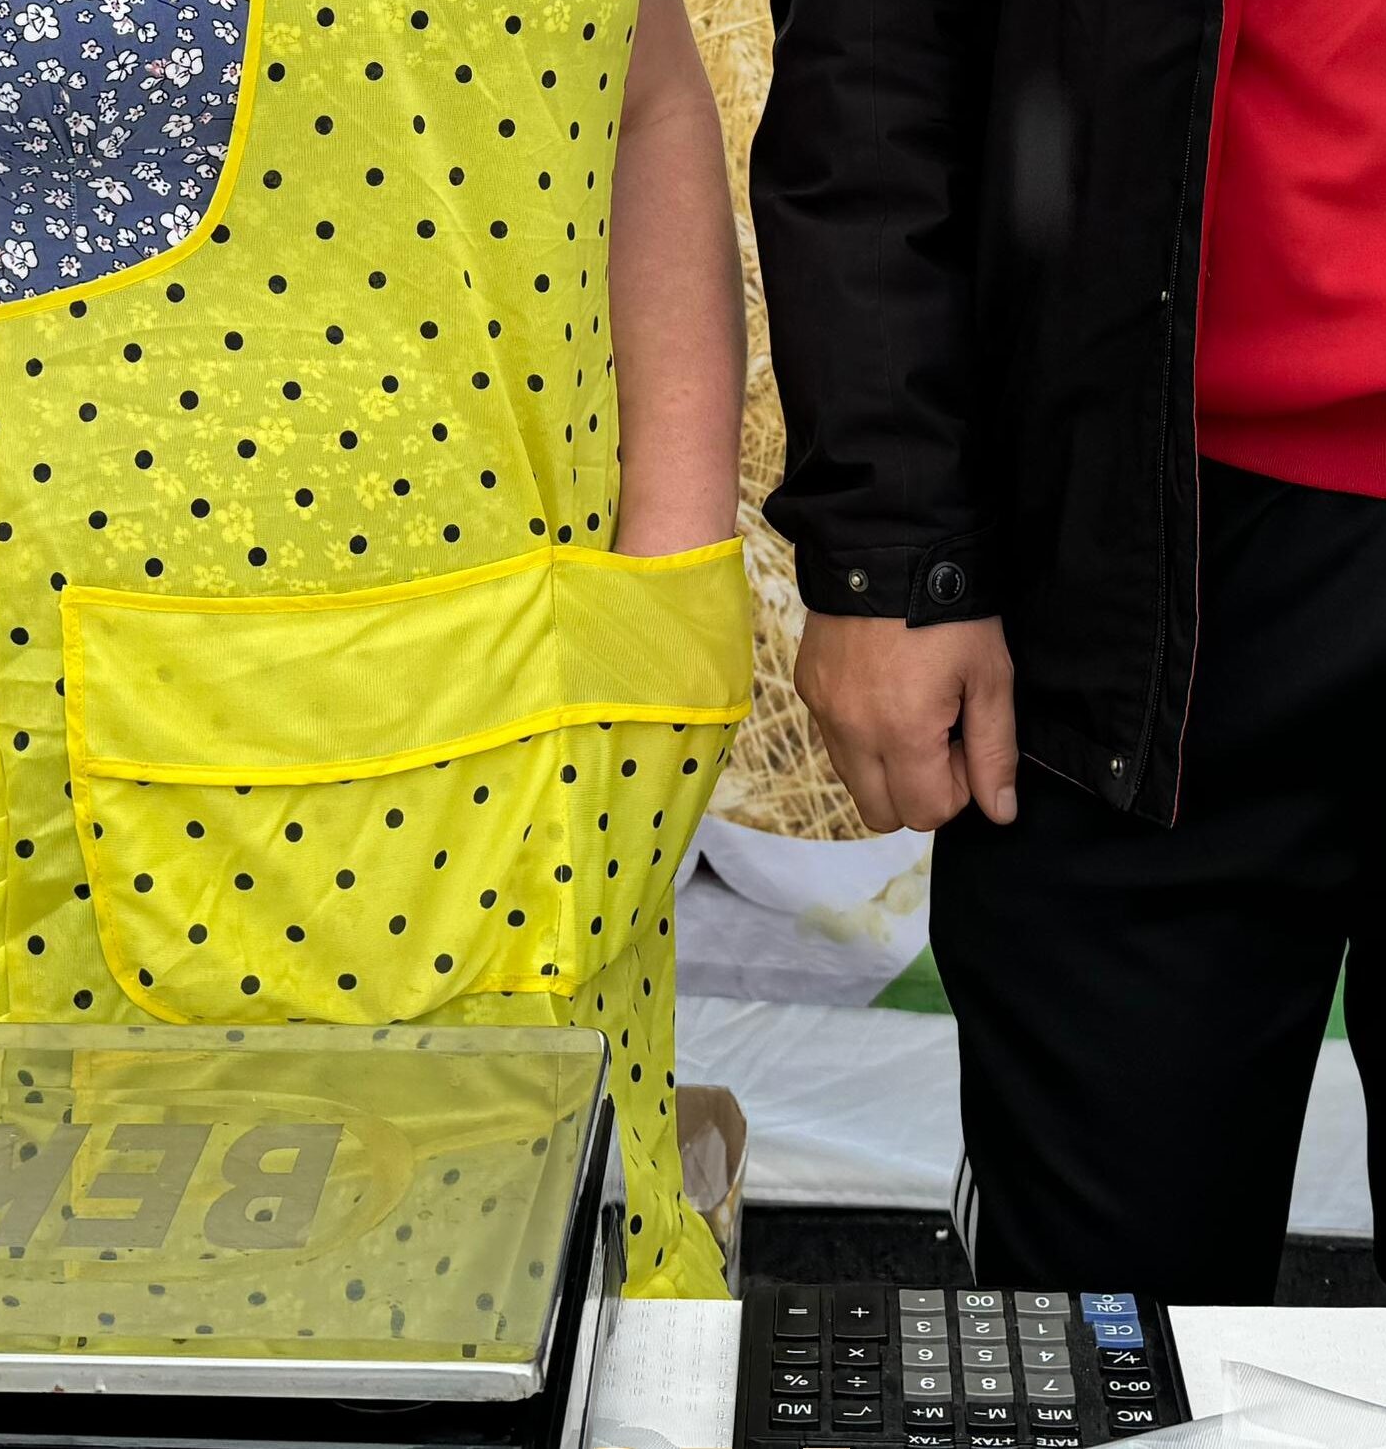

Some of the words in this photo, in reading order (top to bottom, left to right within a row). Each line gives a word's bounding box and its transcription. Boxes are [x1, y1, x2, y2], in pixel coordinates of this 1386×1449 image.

[778, 1402, 812, 1415] MU
[1037, 1408, 1072, 1420] MR
[1117, 1409, 1153, 1422] MC
[1036, 1436, 1079, 1447] RATE
